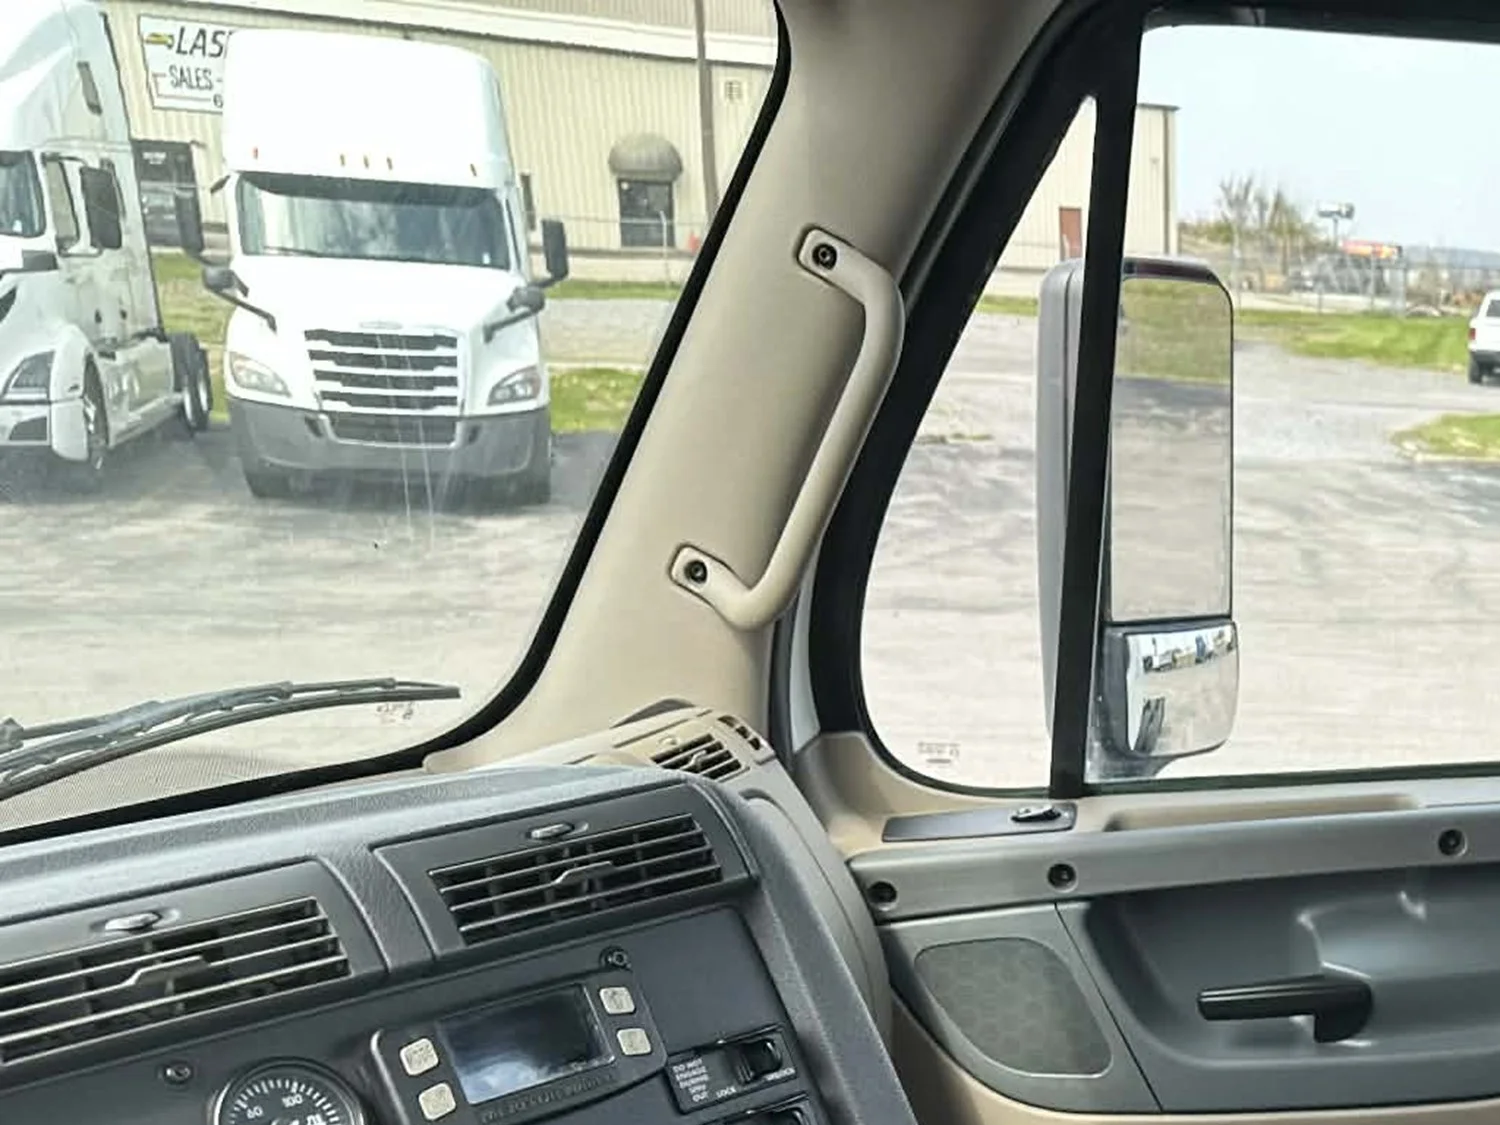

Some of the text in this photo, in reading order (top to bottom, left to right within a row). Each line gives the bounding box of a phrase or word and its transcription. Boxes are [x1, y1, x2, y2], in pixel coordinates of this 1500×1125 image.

[176, 26, 230, 58] LAS
[169, 64, 214, 91] SALES
[672, 1058, 702, 1073] DO NOT
[675, 1066, 708, 1081] ENGAGE
[692, 1091, 708, 1102] OUT
[715, 1086, 737, 1098] LOCK
[282, 1094, 303, 1108] 100
[246, 1105, 263, 1119] 60
